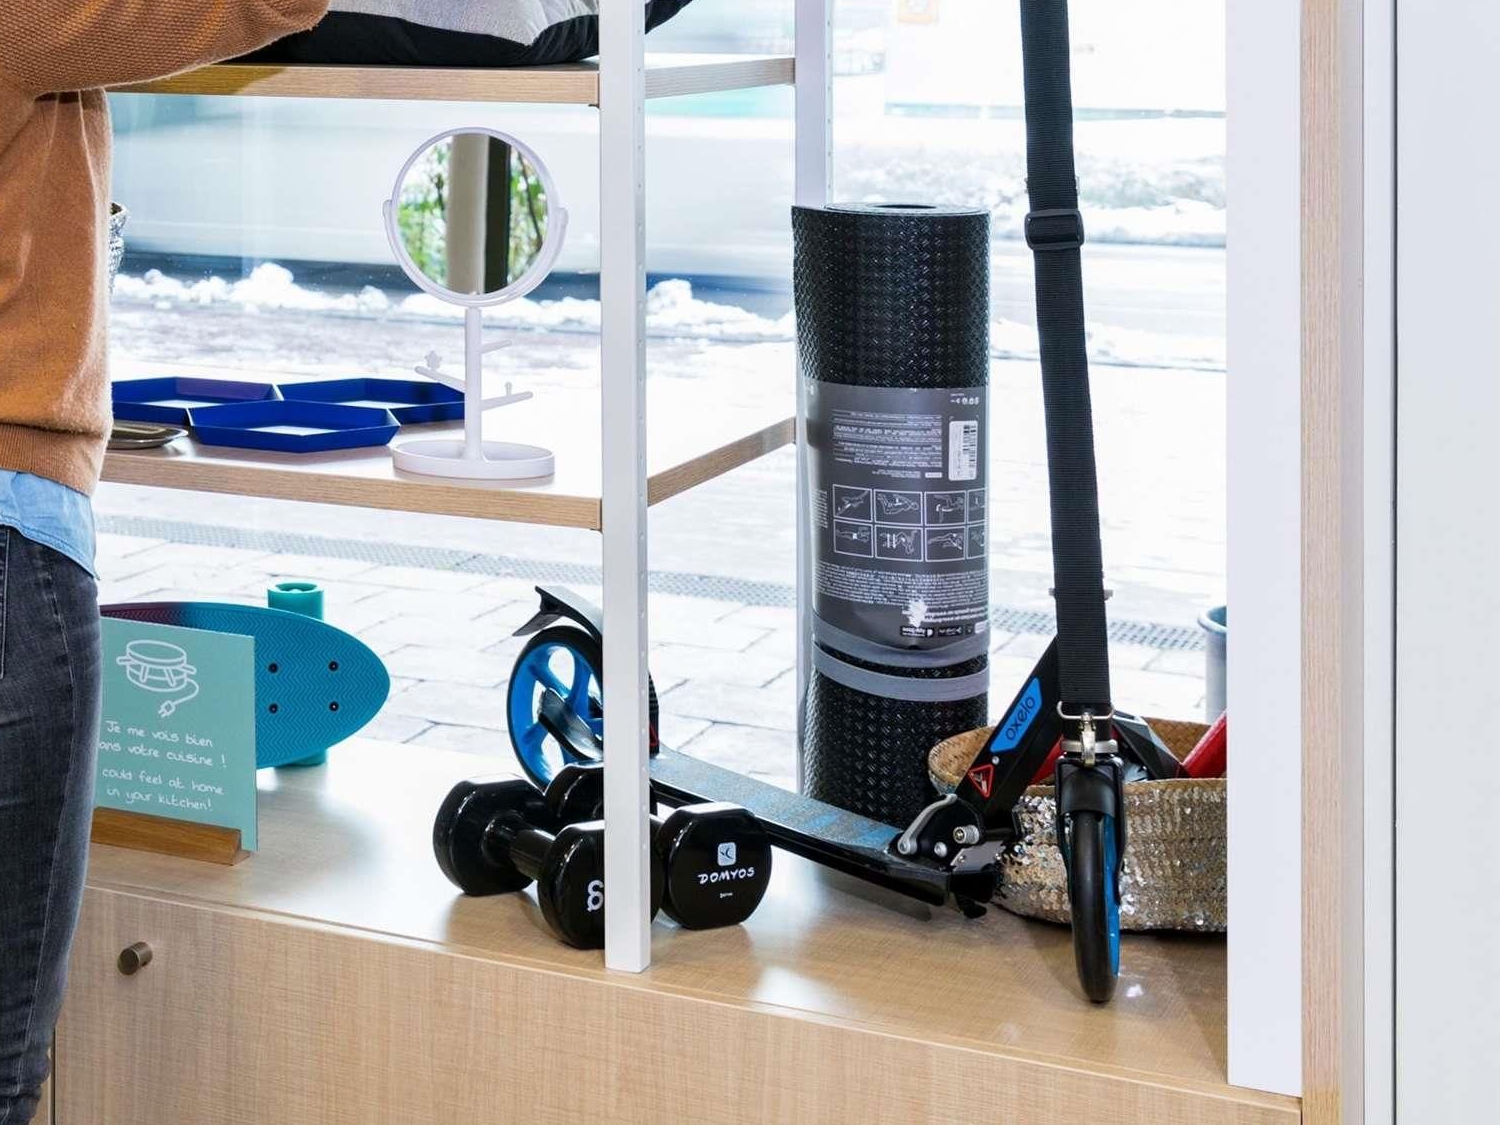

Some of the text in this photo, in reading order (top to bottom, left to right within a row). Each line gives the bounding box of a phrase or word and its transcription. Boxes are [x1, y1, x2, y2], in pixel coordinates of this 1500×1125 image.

[1005, 696, 1036, 741] oxelo
[105, 720, 213, 748] Je me vois bien
[99, 740, 121, 752] ans
[127, 743, 160, 758] votre
[166, 751, 213, 767] cuisine
[101, 768, 225, 796] could feel at home
[106, 787, 213, 812] in your kitchen!
[697, 867, 755, 885] DOMYOS
